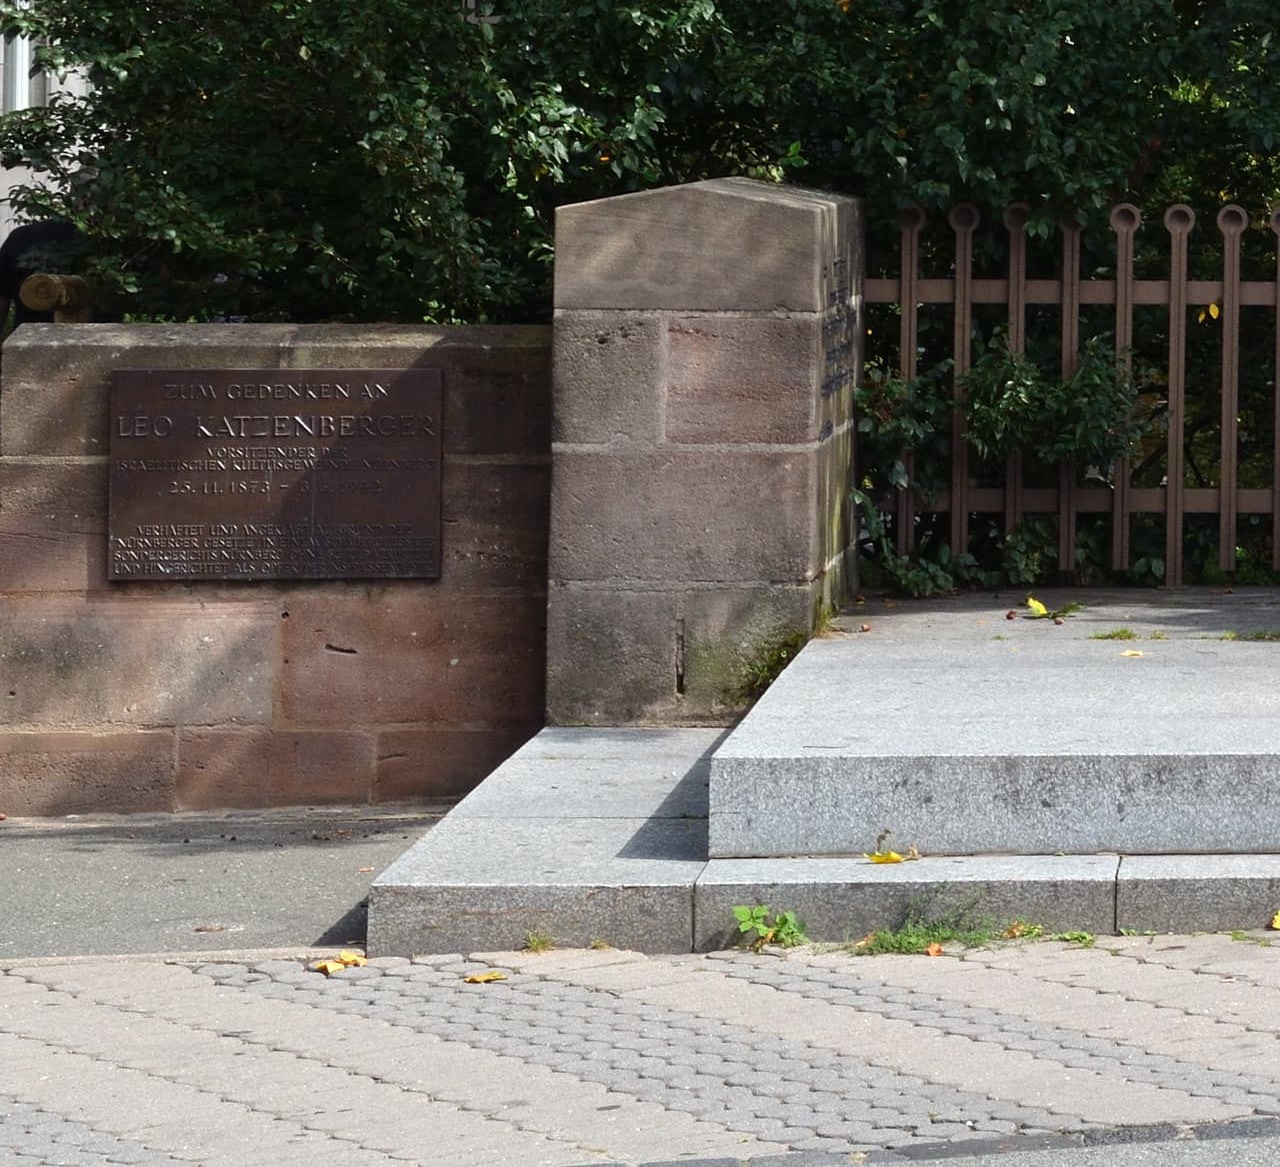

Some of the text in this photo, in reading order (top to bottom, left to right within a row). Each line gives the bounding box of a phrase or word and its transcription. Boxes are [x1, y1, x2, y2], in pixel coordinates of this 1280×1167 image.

[163, 383, 391, 400] ZUM GEDENKEN AN
[117, 414, 437, 438] LEO KATZENBERGER
[206, 446, 317, 459] VORSITZENDER
[229, 481, 271, 495] 1873
[136, 523, 206, 536] VERHAFTET
[208, 523, 239, 536] UND
[116, 536, 201, 549] NÜRNBERGER
[113, 549, 219, 562] SONDERGERICHTS
[113, 562, 141, 575] UND
